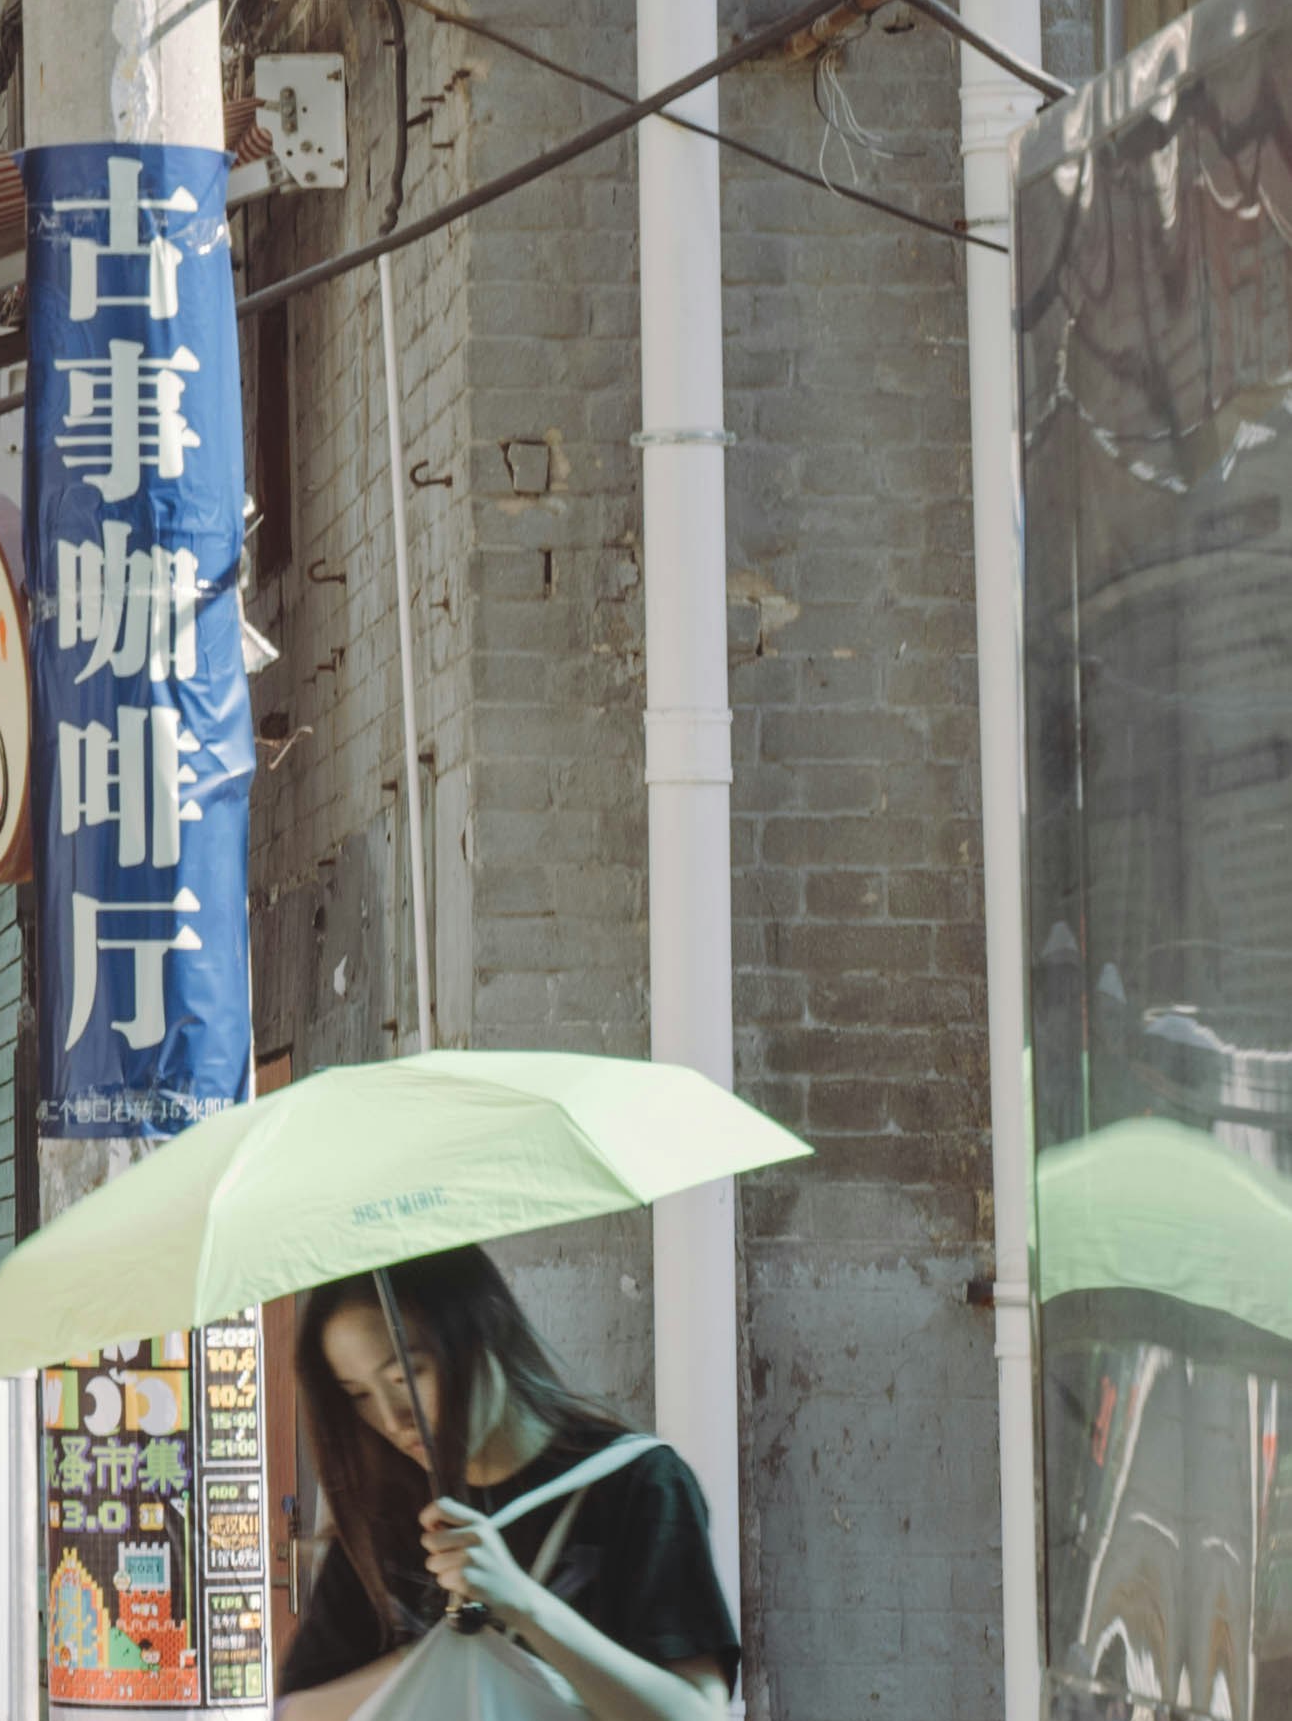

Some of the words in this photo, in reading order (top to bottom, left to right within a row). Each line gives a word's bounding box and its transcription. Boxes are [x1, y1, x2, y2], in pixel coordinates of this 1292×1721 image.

[52, 158, 202, 1051] 古事咖啡厅
[207, 1327, 256, 1348] 2021
[207, 1385, 257, 1409] 10.7
[62, 1500, 129, 1532] 3.0
